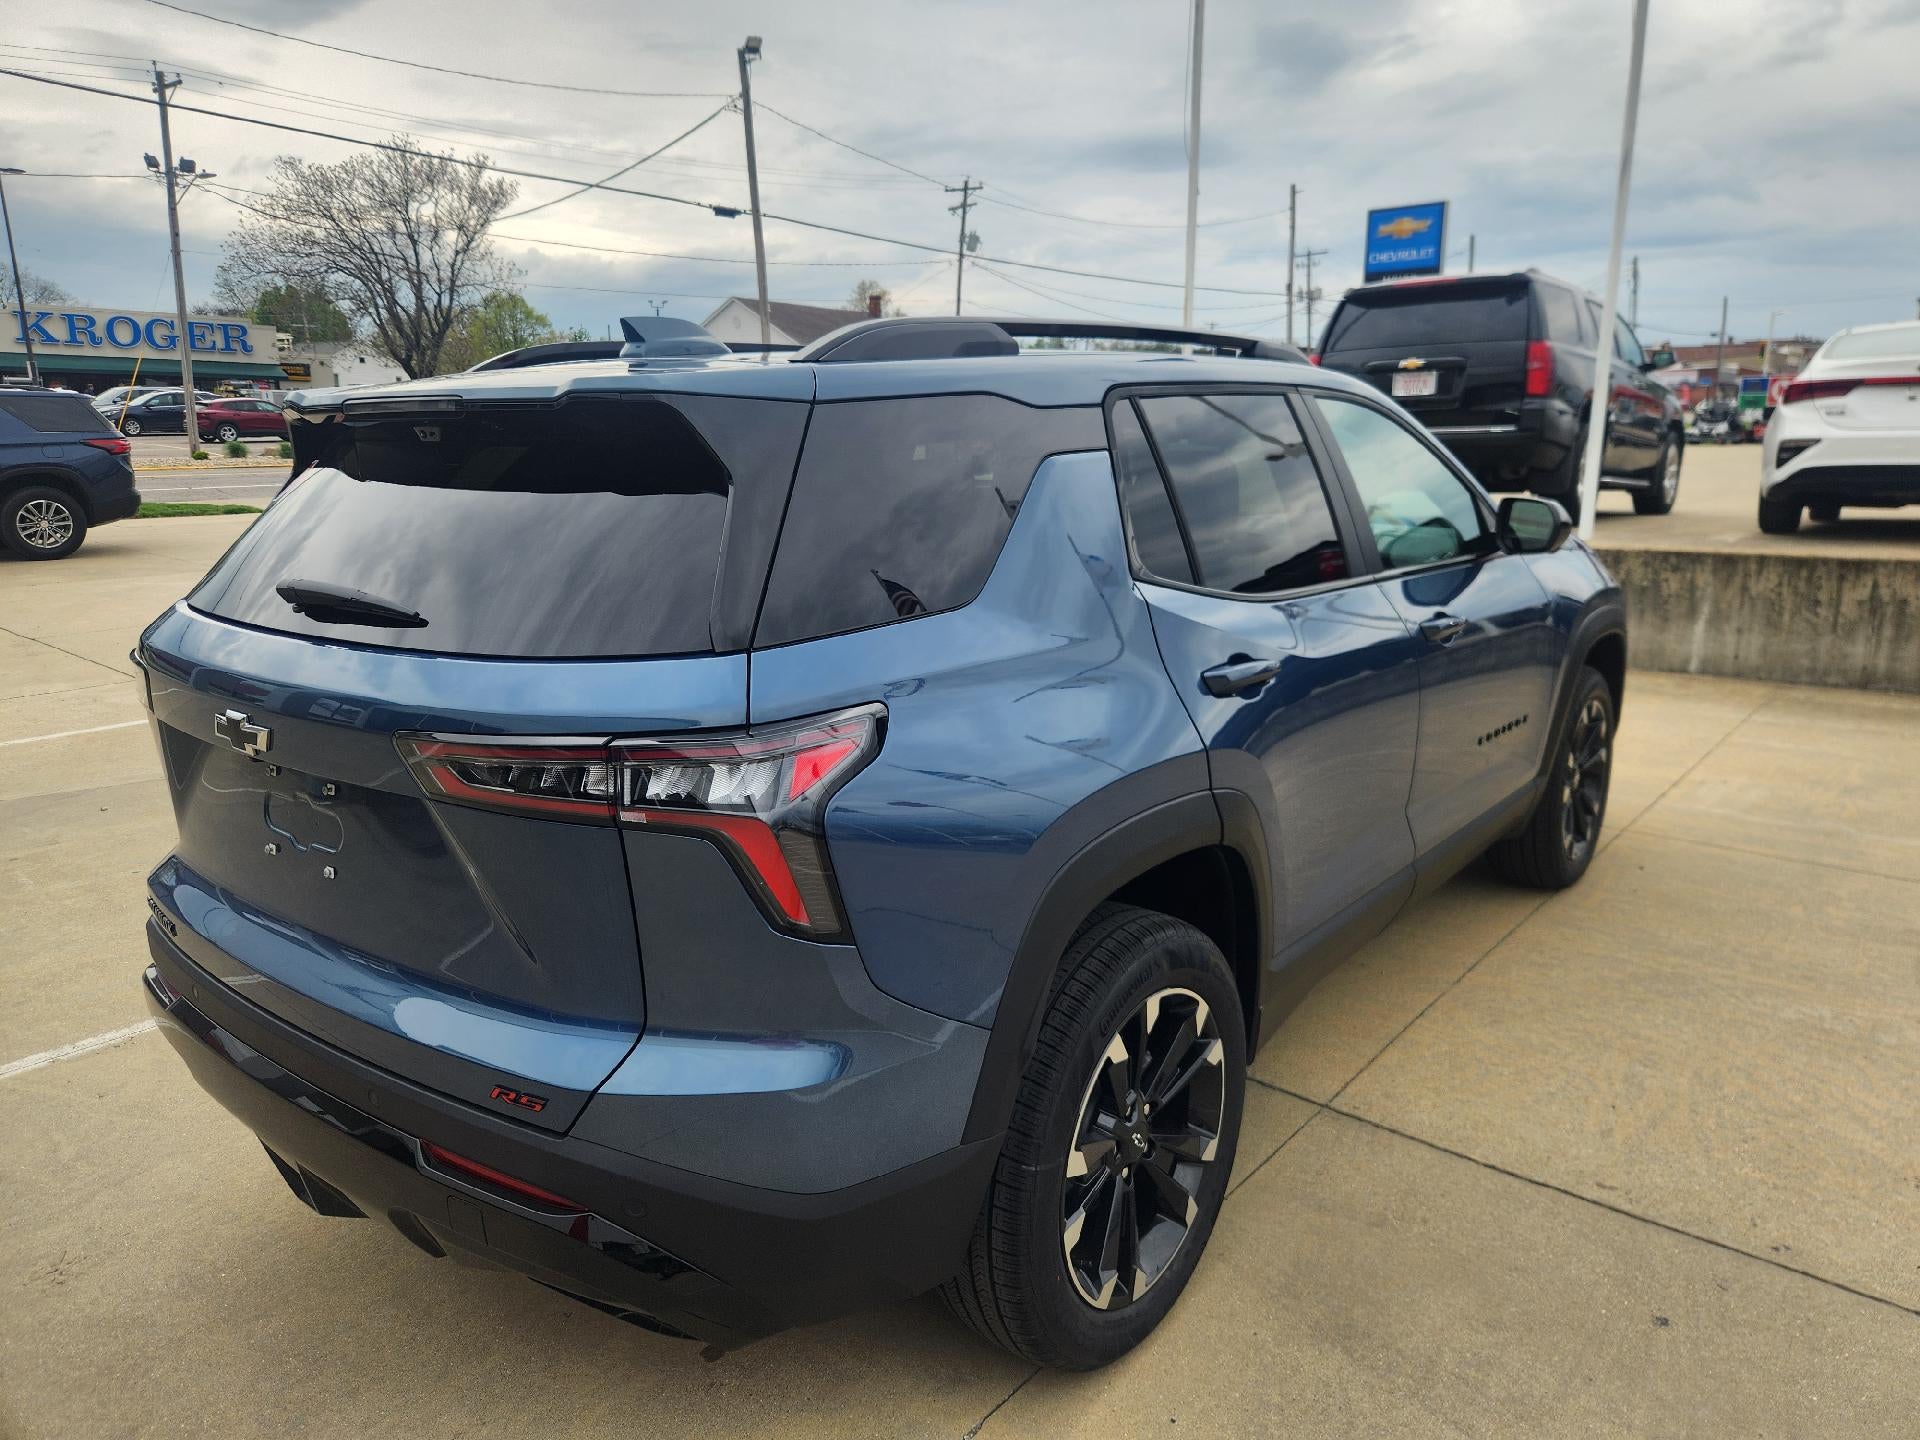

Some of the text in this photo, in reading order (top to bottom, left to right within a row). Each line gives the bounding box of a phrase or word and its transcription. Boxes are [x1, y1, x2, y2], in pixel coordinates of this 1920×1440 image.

[1368, 247, 1435, 264] CHEVROLET
[12, 311, 253, 354] KROGER
[490, 1086, 546, 1112] RS
